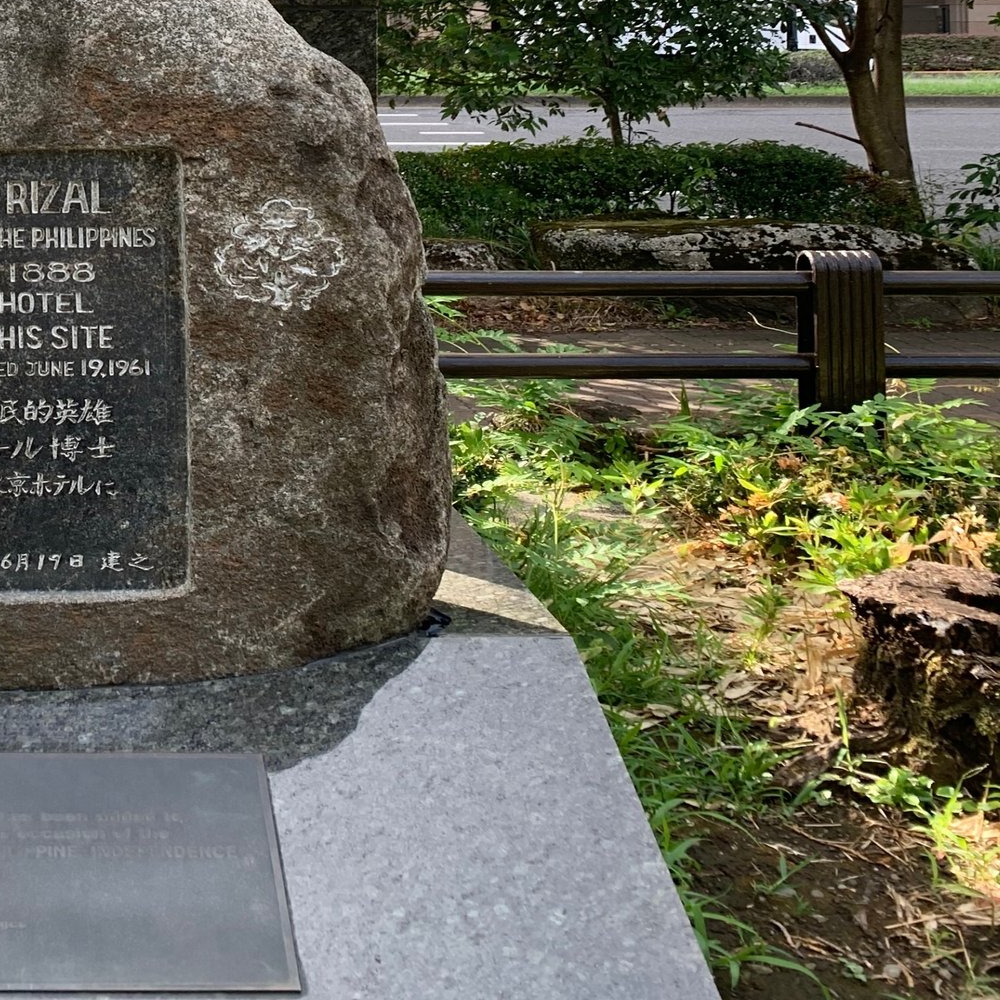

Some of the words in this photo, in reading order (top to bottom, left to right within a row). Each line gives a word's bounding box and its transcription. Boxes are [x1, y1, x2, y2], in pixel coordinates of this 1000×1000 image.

[6, 179, 112, 216] RIZAL
[31, 228, 156, 249] PHILIPPINES
[9, 262, 97, 284] 1888
[51, 325, 115, 350] SITE
[25, 361, 75, 377] JUNE
